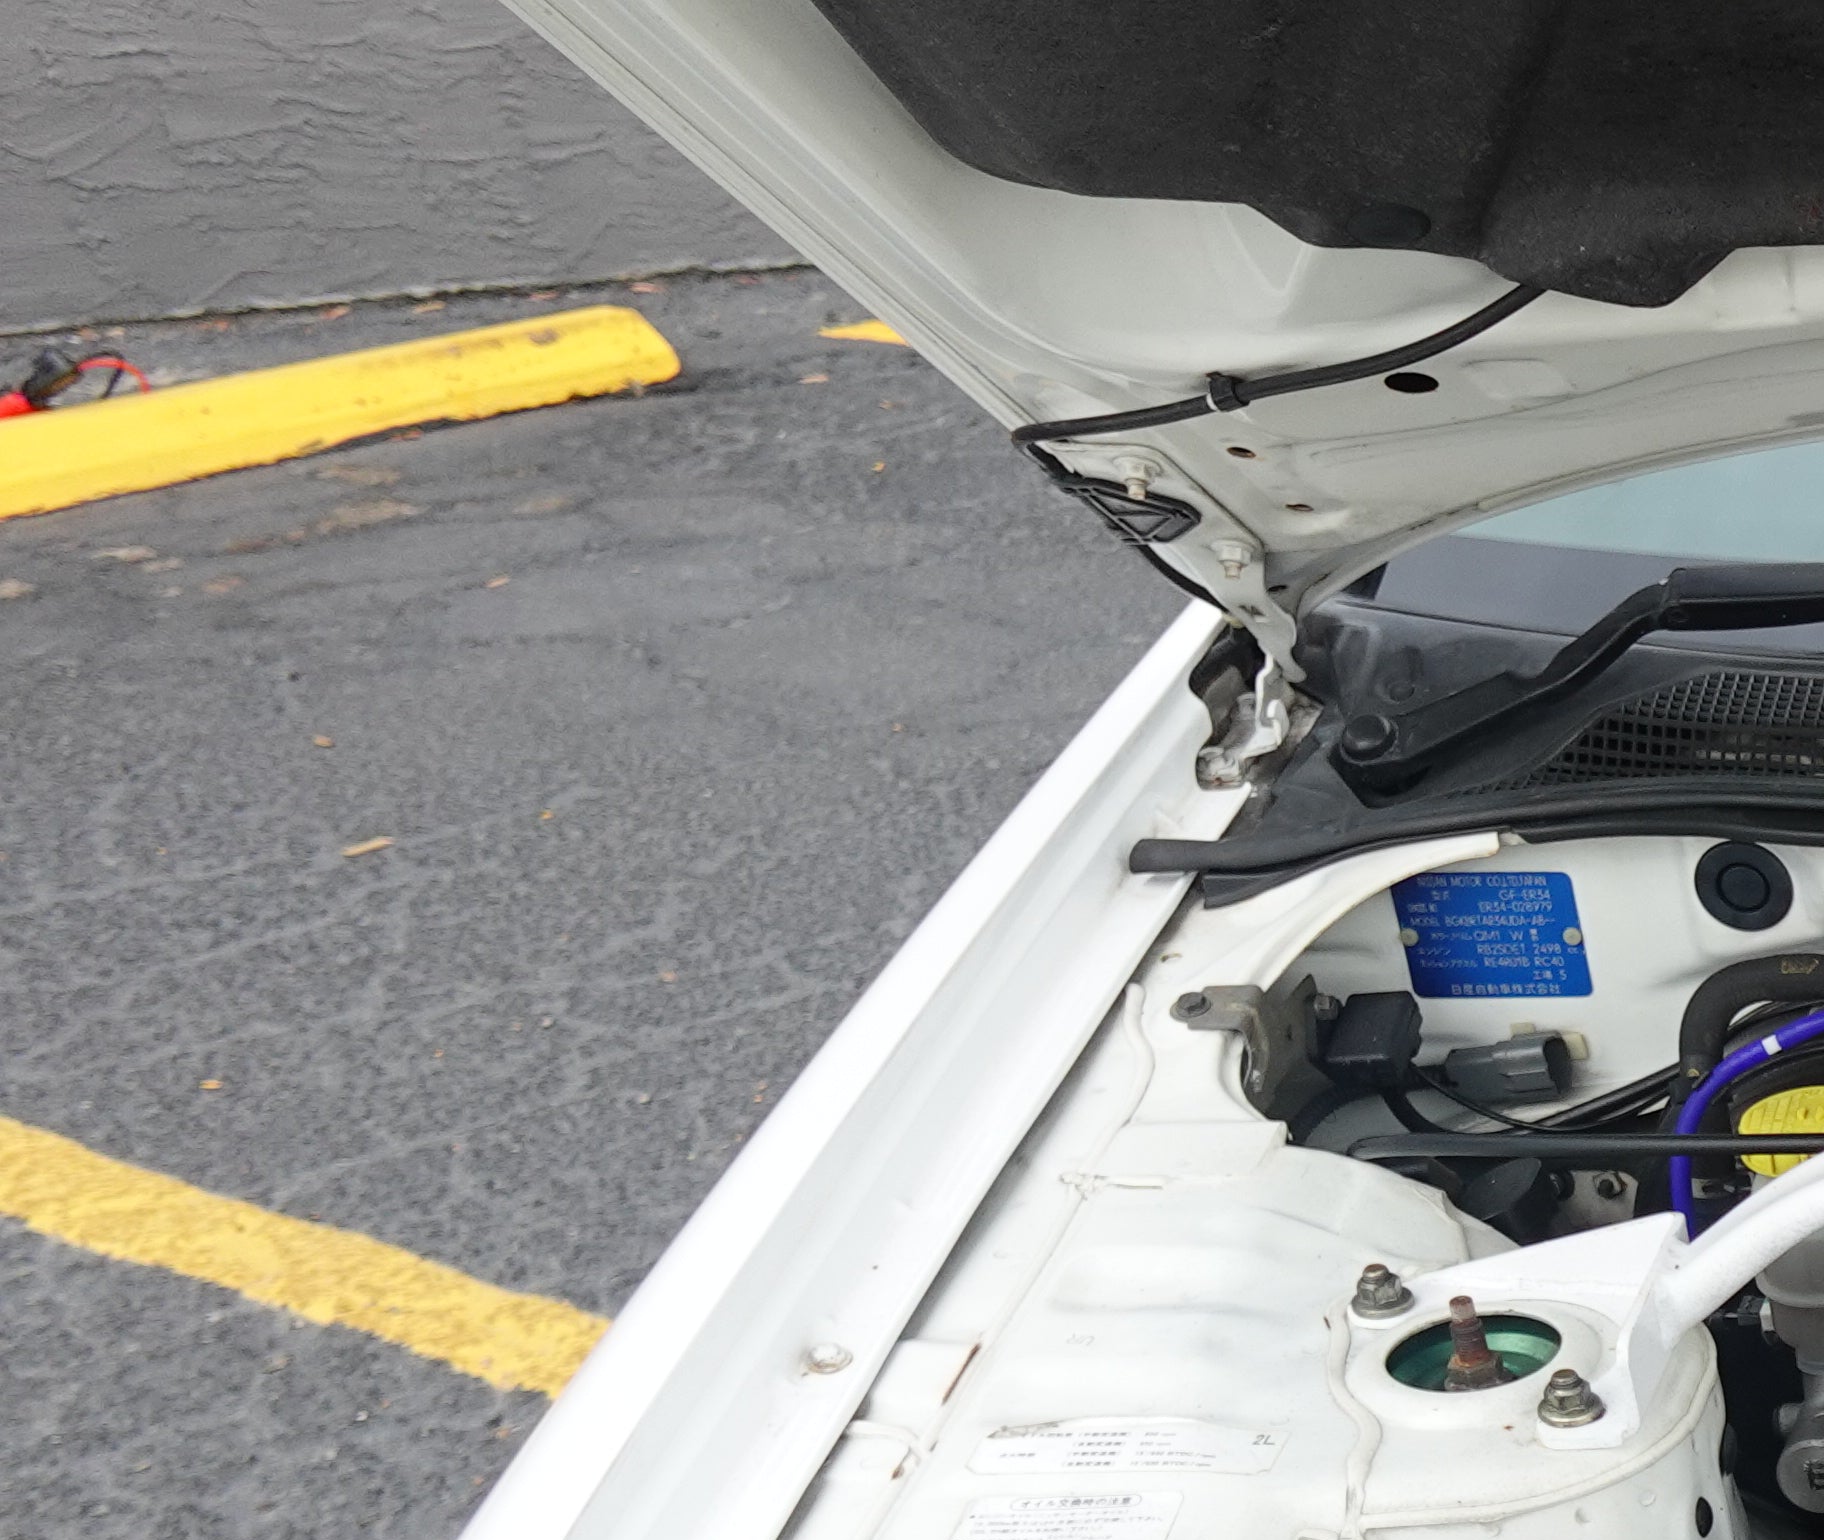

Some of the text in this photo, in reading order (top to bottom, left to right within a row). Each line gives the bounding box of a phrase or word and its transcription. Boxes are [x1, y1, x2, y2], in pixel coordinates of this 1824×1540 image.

[1533, 943, 1562, 955] 2498
[1451, 983, 1562, 995] 日産自動車株式会社
